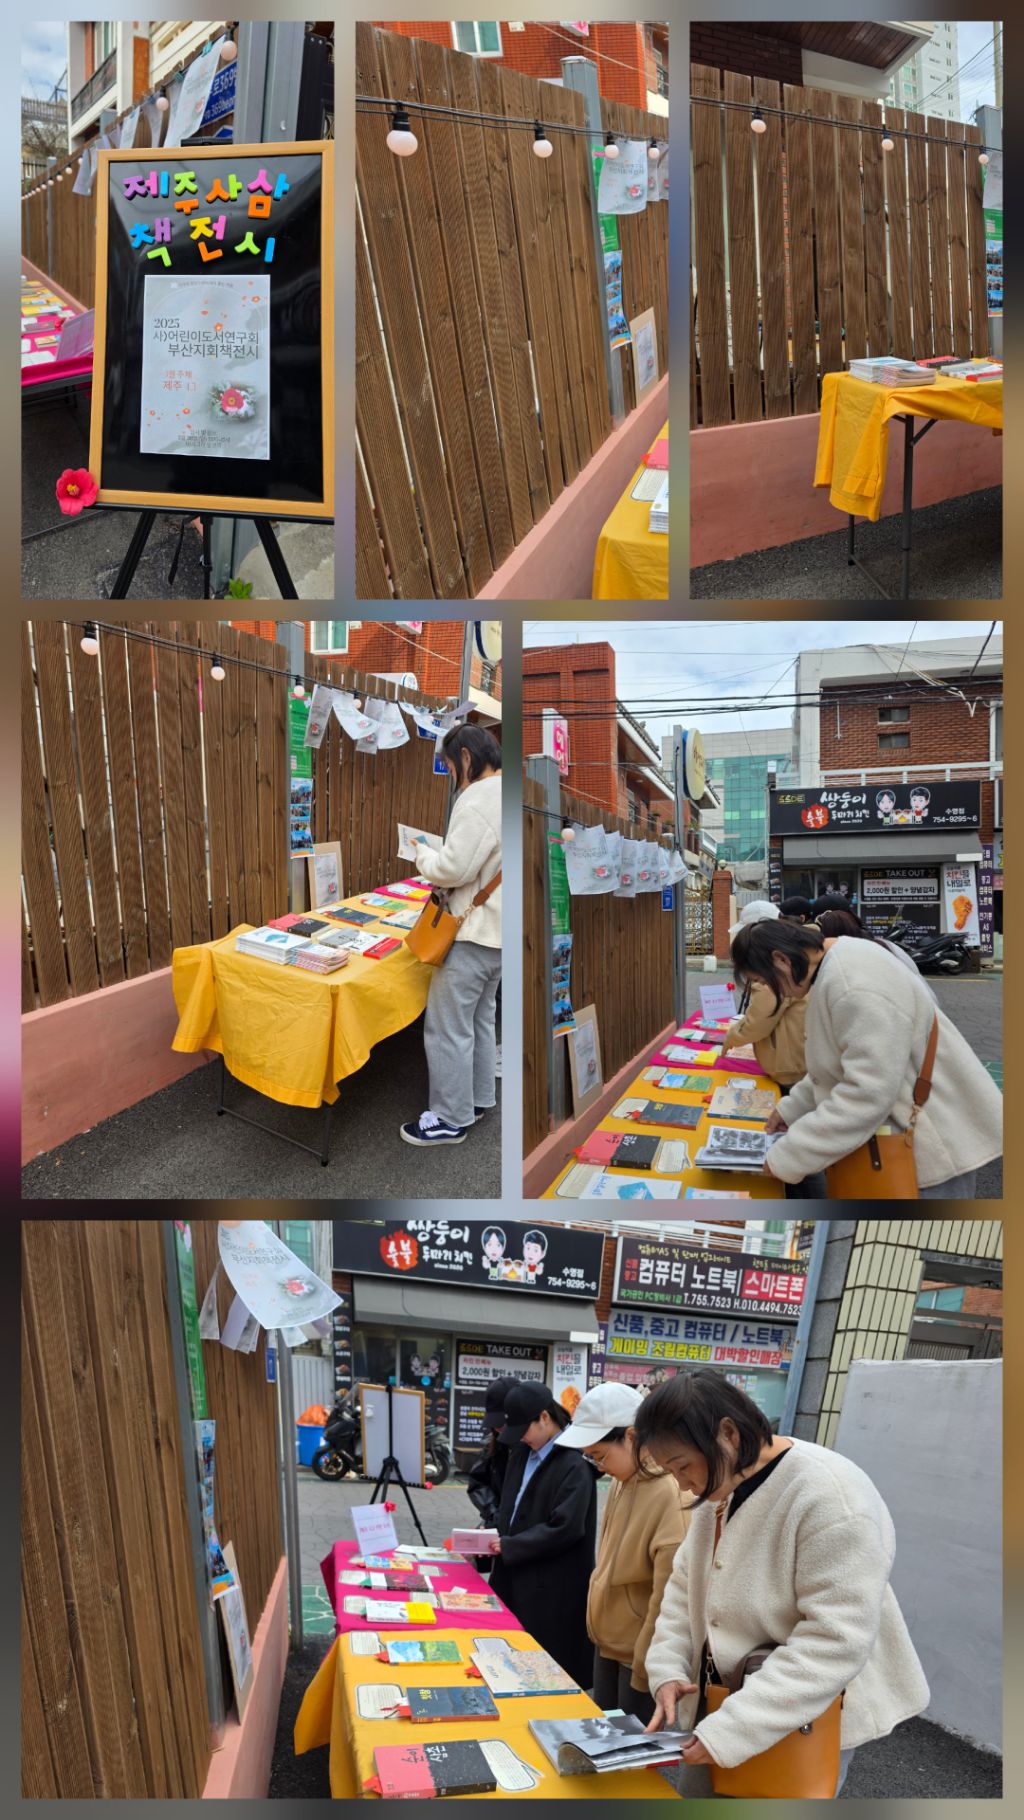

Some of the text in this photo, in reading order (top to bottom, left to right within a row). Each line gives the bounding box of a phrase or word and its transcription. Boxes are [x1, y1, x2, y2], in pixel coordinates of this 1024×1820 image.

[154, 318, 180, 328] 2025
[168, 343, 259, 359] 부산지회책전시
[820, 791, 867, 809] 쌍둥이
[932, 815, 978, 823] 754-9295~6
[885, 869, 907, 878] TAKE
[908, 869, 925, 877] OUT
[866, 886, 890, 894] 2,000원
[406, 1220, 470, 1246] 쌍둥이
[562, 1267, 585, 1278] 수영점
[547, 1277, 597, 1290] 754-9295~6
[639, 1258, 804, 1301] 컴퓨터 노트북 스마트폰
[684, 1292, 731, 1308] T.755.7523
[613, 1313, 680, 1338] 신품,중고
[684, 1320, 726, 1342] 컴퓨터
[741, 1326, 784, 1347] 노트북
[486, 1345, 511, 1356] TAKE
[512, 1347, 533, 1356] OUT
[609, 1336, 649, 1356] 게이밍
[714, 1345, 783, 1366] 대박할인매장
[462, 1367, 490, 1377] 2,000원
